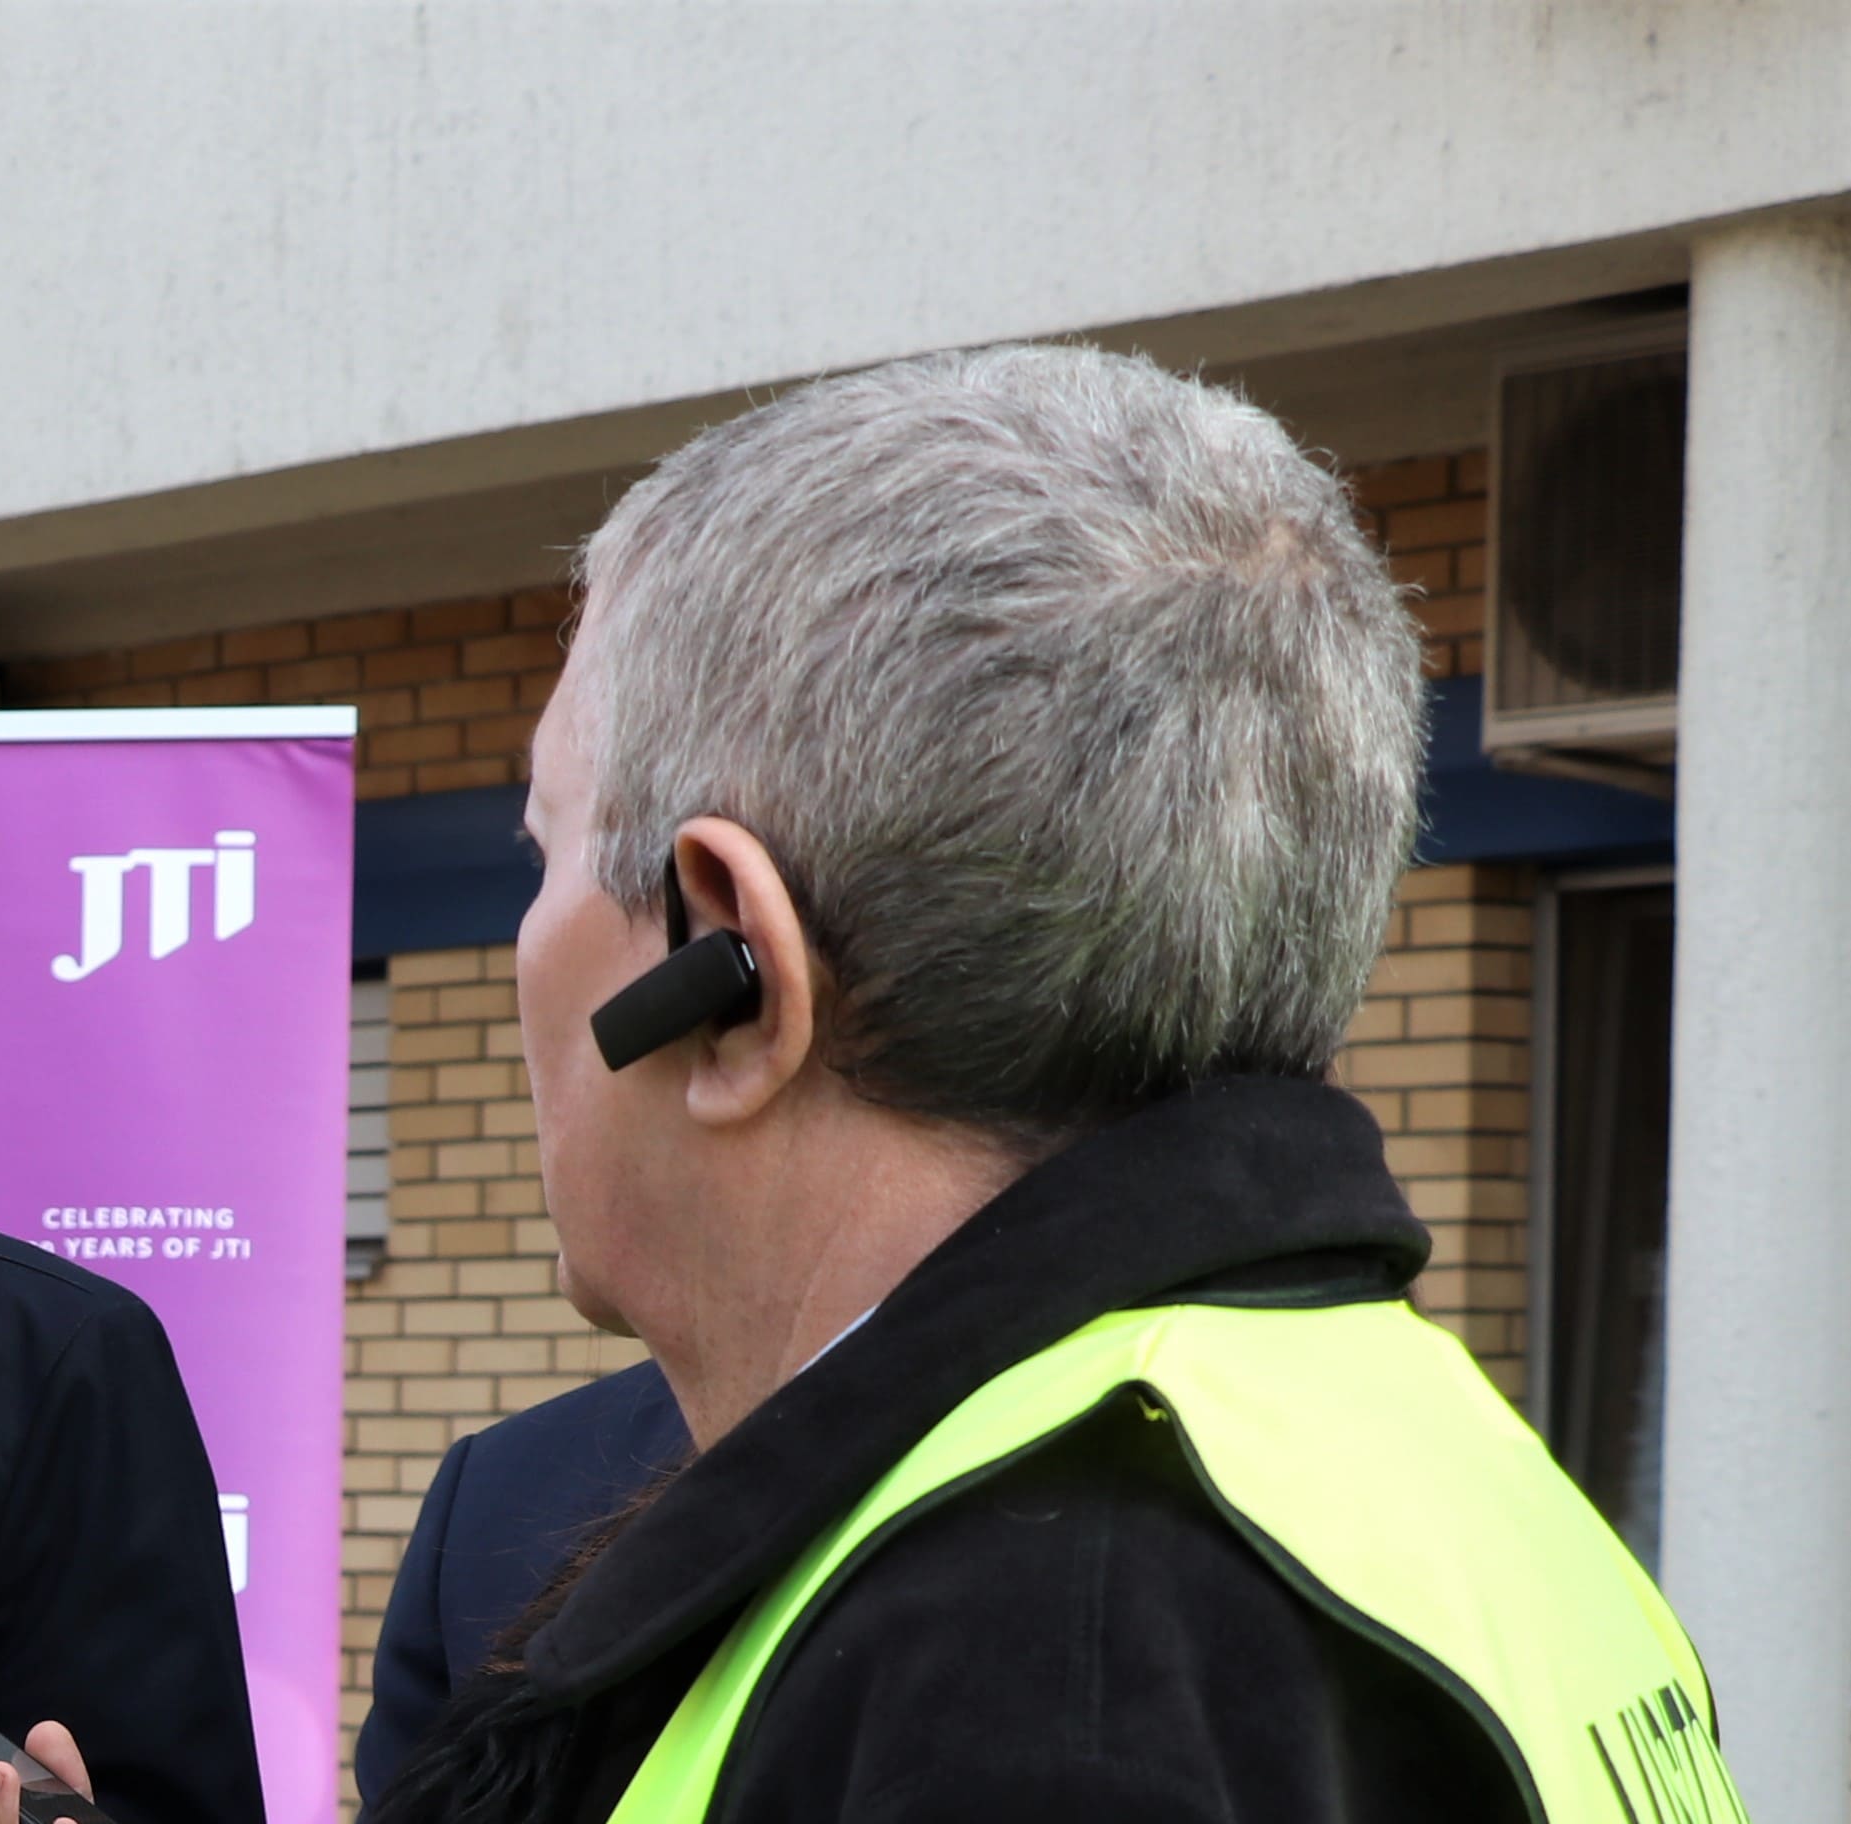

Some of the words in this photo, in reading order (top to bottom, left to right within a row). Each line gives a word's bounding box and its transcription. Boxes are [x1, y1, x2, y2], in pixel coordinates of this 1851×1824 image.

[42, 1207, 234, 1229] CELEBRATING
[64, 1237, 153, 1258] YEARS
[163, 1237, 201, 1258] OF
[211, 1237, 251, 1259] JTI
